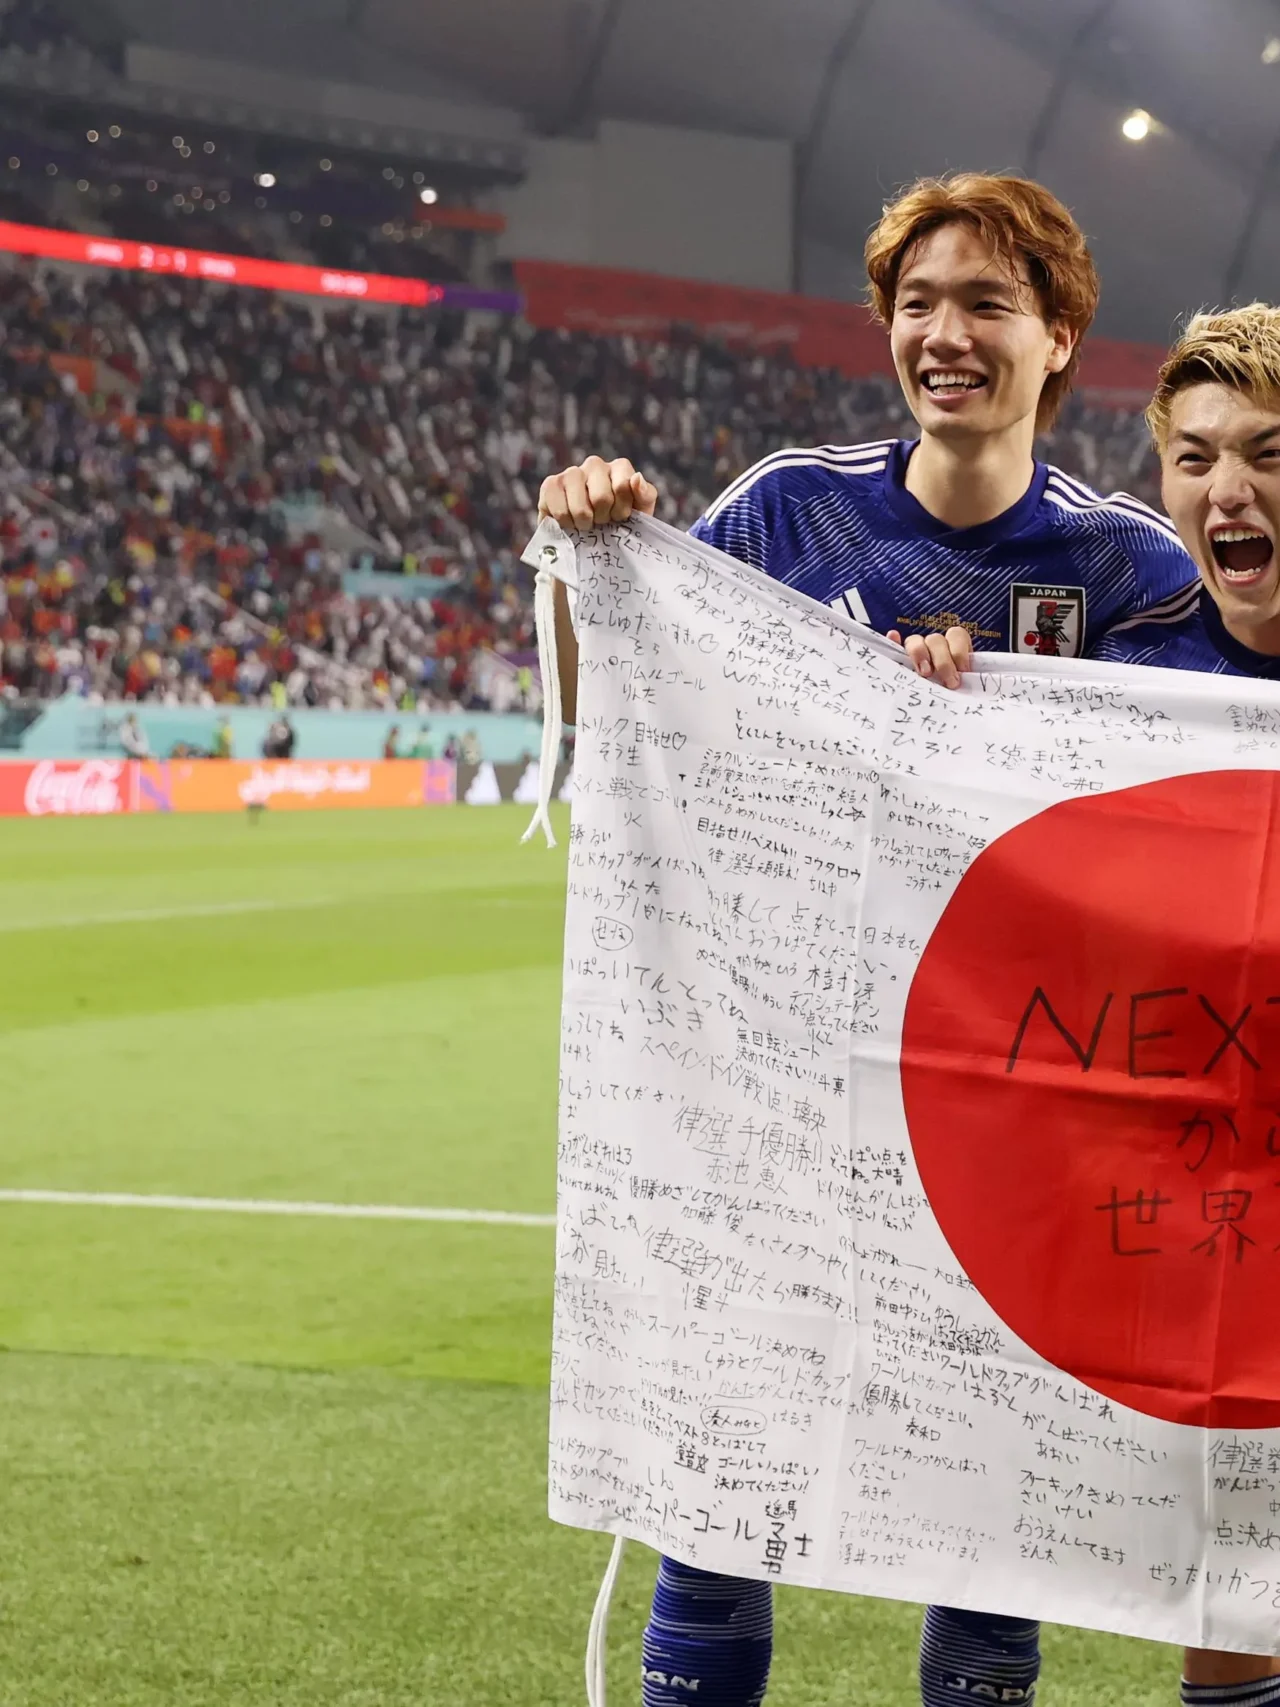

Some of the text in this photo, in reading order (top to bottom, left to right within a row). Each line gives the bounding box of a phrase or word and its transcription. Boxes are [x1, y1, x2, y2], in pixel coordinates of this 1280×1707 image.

[1030, 587, 1067, 597] JAPAN
[804, 855, 862, 885] コウタロウ
